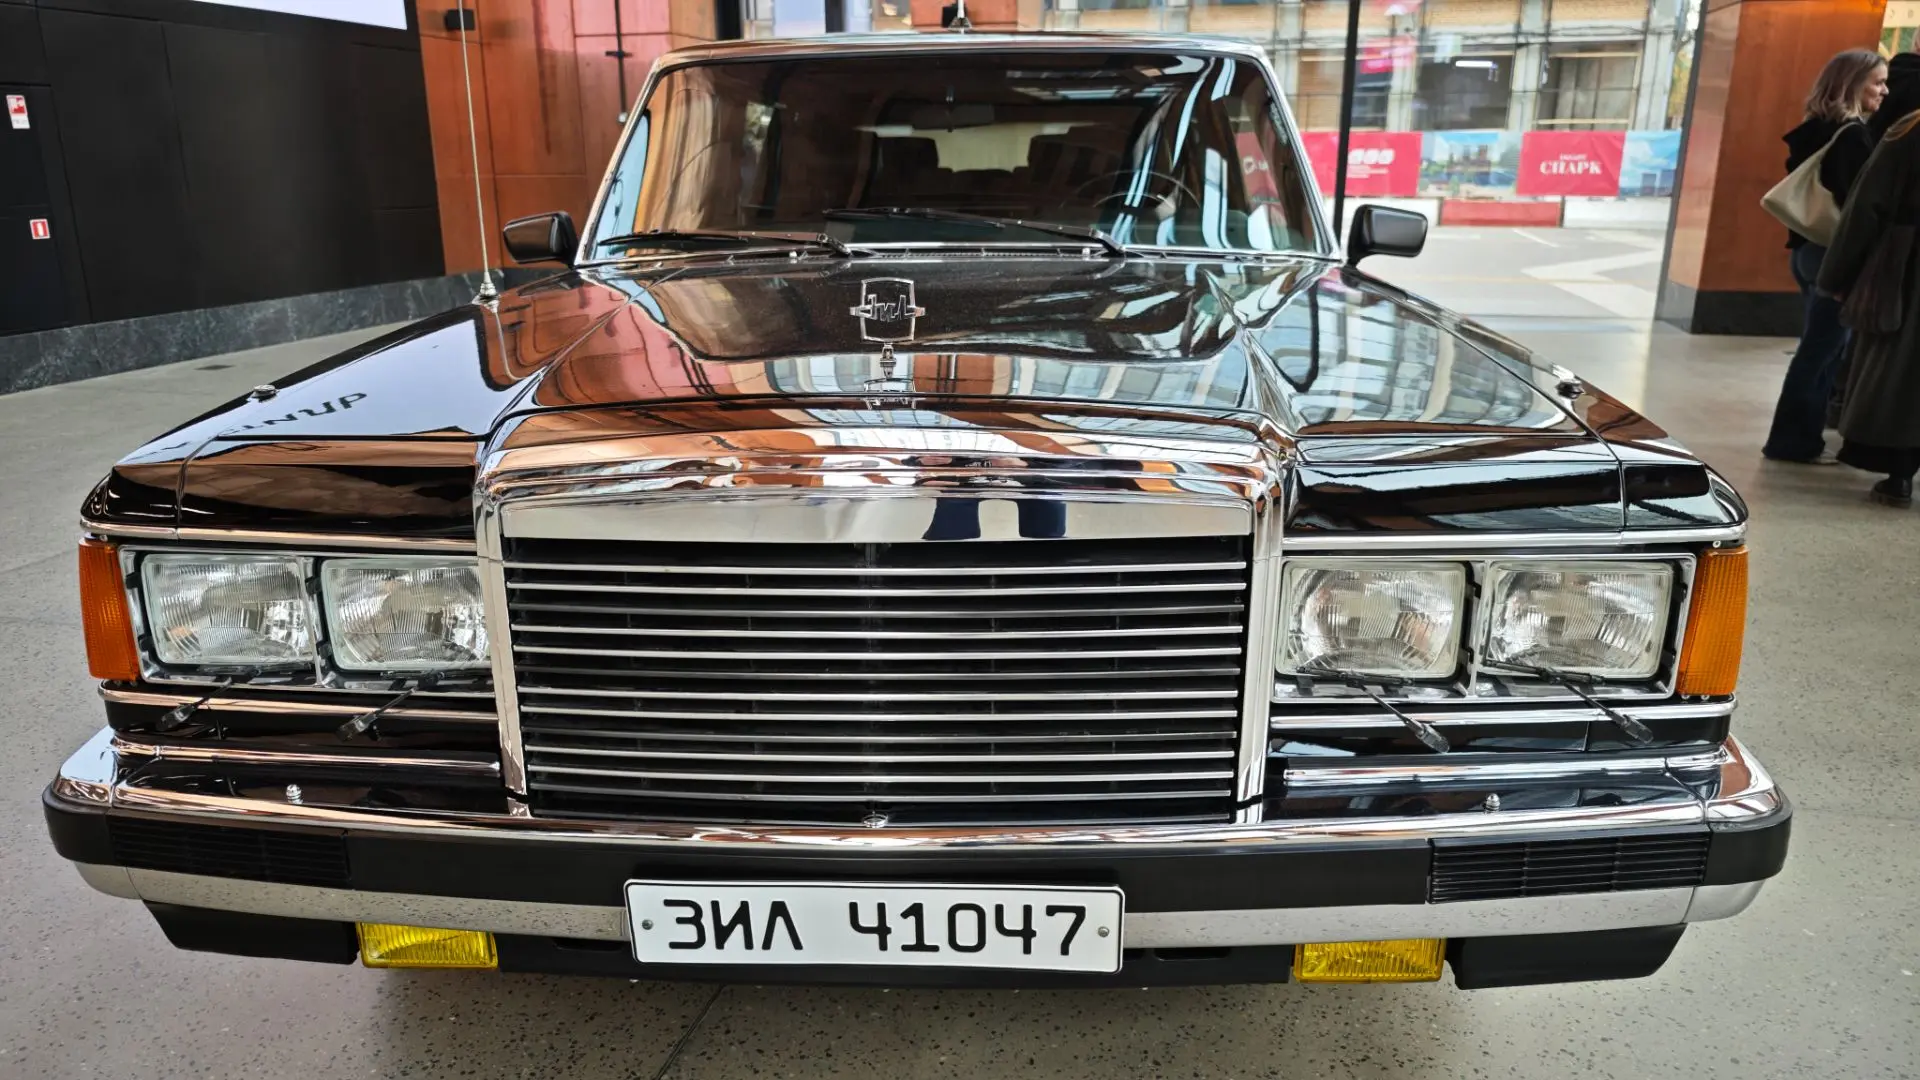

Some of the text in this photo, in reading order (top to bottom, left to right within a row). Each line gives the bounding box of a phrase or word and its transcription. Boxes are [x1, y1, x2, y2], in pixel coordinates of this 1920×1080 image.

[1540, 160, 1603, 175] СПАРК
[663, 898, 1087, 956] ЗИЛ 41047
